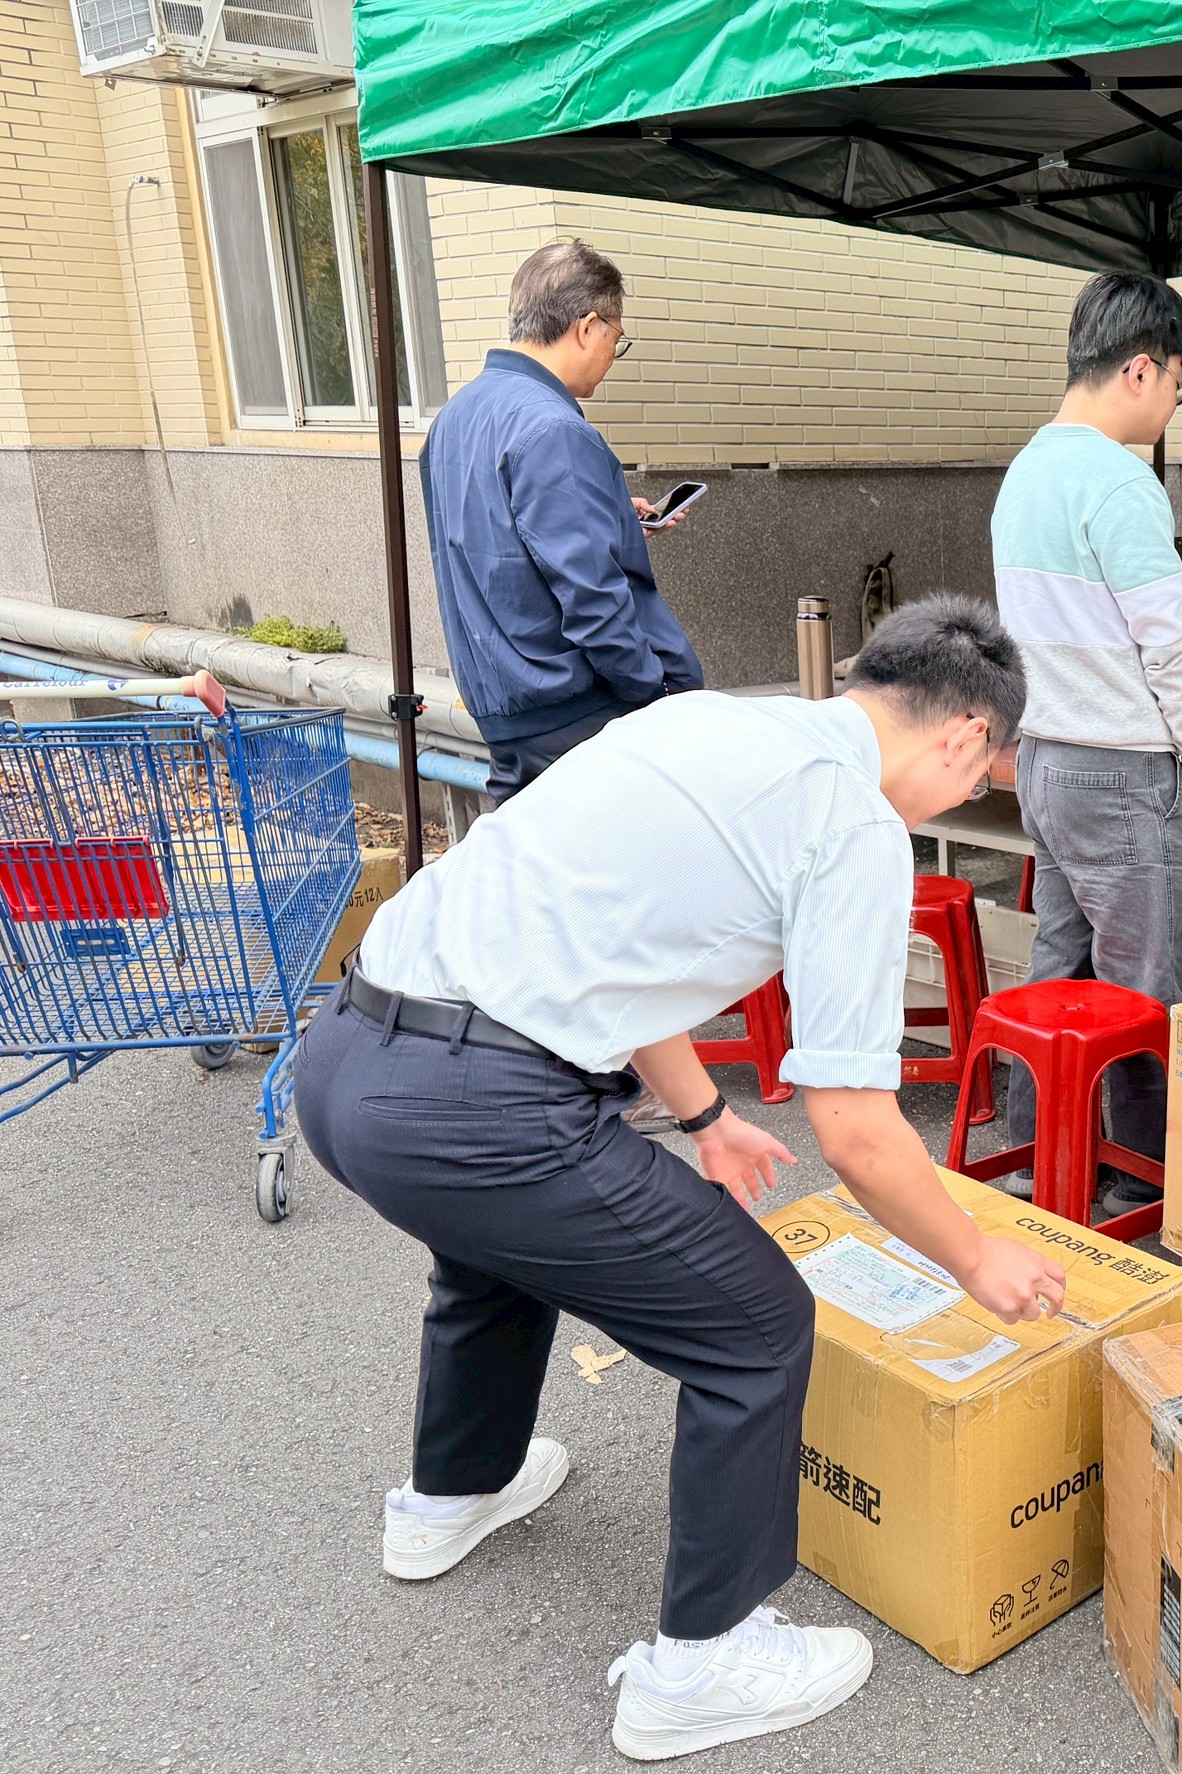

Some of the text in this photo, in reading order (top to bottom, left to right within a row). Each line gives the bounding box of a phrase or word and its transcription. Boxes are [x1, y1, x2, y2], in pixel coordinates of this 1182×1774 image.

[784, 1228, 818, 1246] 37
[1015, 1217, 1116, 1266] coupang
[1109, 1257, 1170, 1285] 酷澎
[800, 1441, 881, 1526] 箭速配
[1010, 1459, 1104, 1529] coupan
